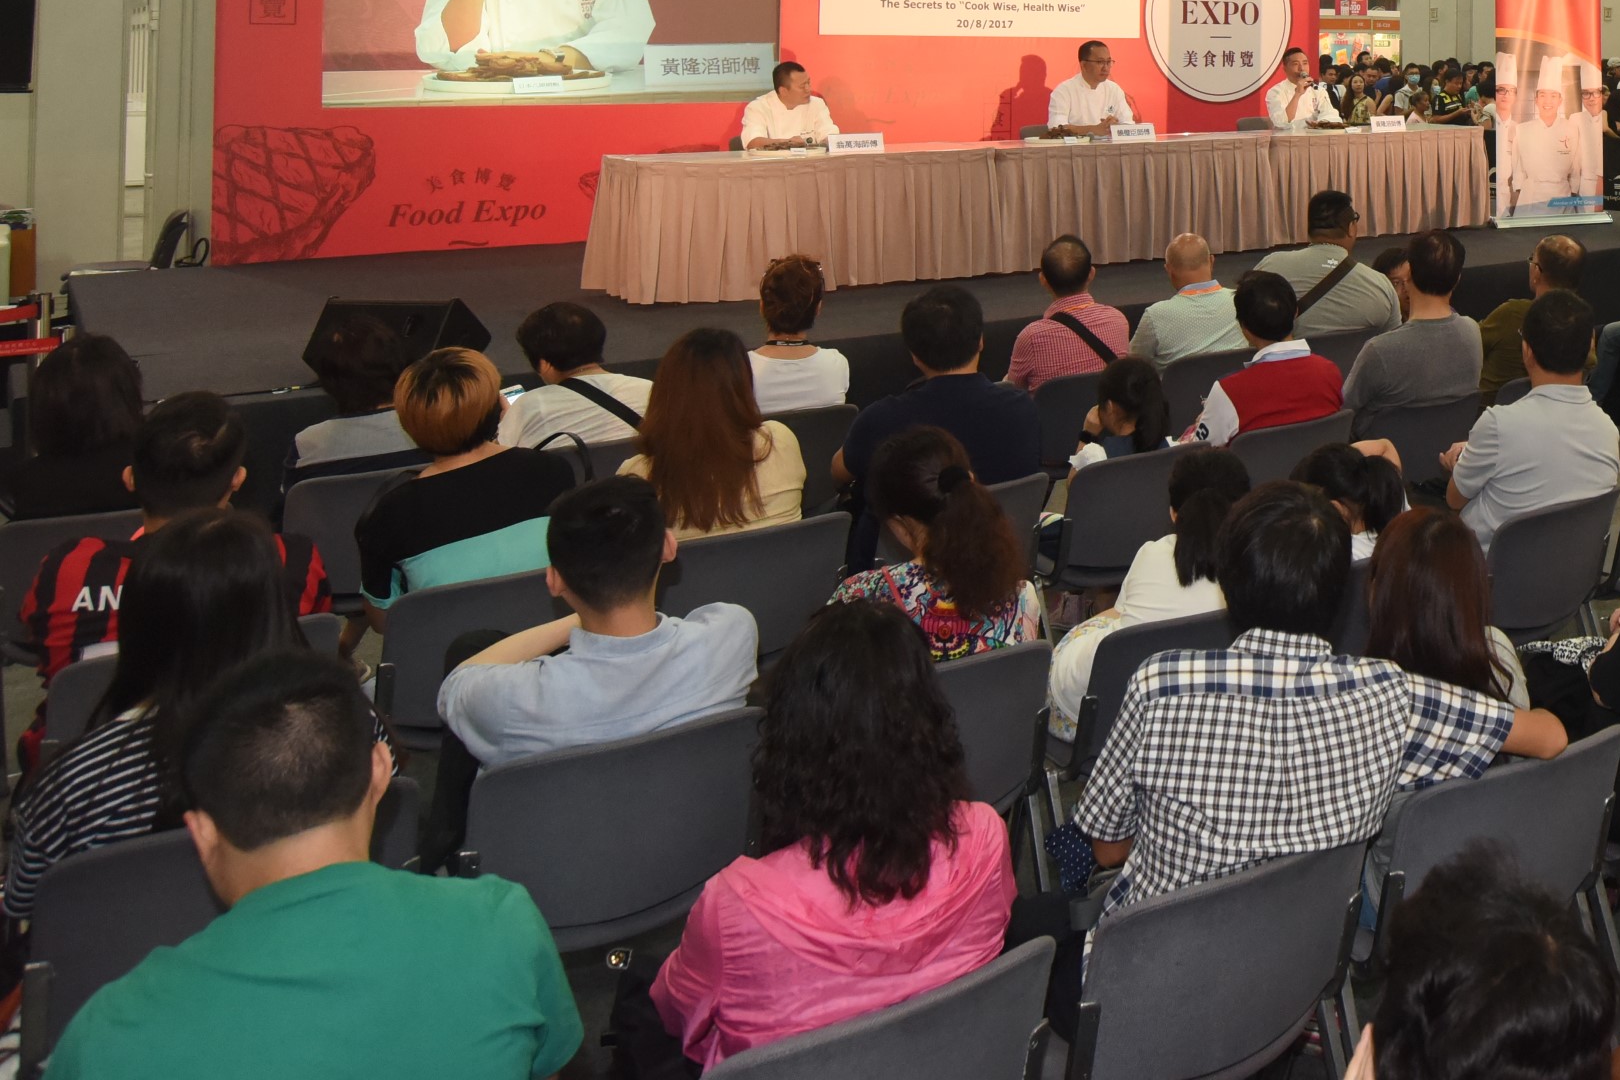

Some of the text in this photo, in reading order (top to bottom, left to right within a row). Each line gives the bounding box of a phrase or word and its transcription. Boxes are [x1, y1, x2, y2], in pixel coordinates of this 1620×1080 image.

[880, 0, 900, 8] The
[904, 0, 943, 10] Secrets
[946, 2, 956, 10] to
[993, 1, 1020, 12] Wise,
[1022, 2, 1055, 12] Health
[1181, 0, 1260, 25] EXPO
[956, 19, 1014, 29] 20/8/2017
[1183, 50, 1254, 68] 美食博覽
[387, 199, 547, 228] Food Expo
